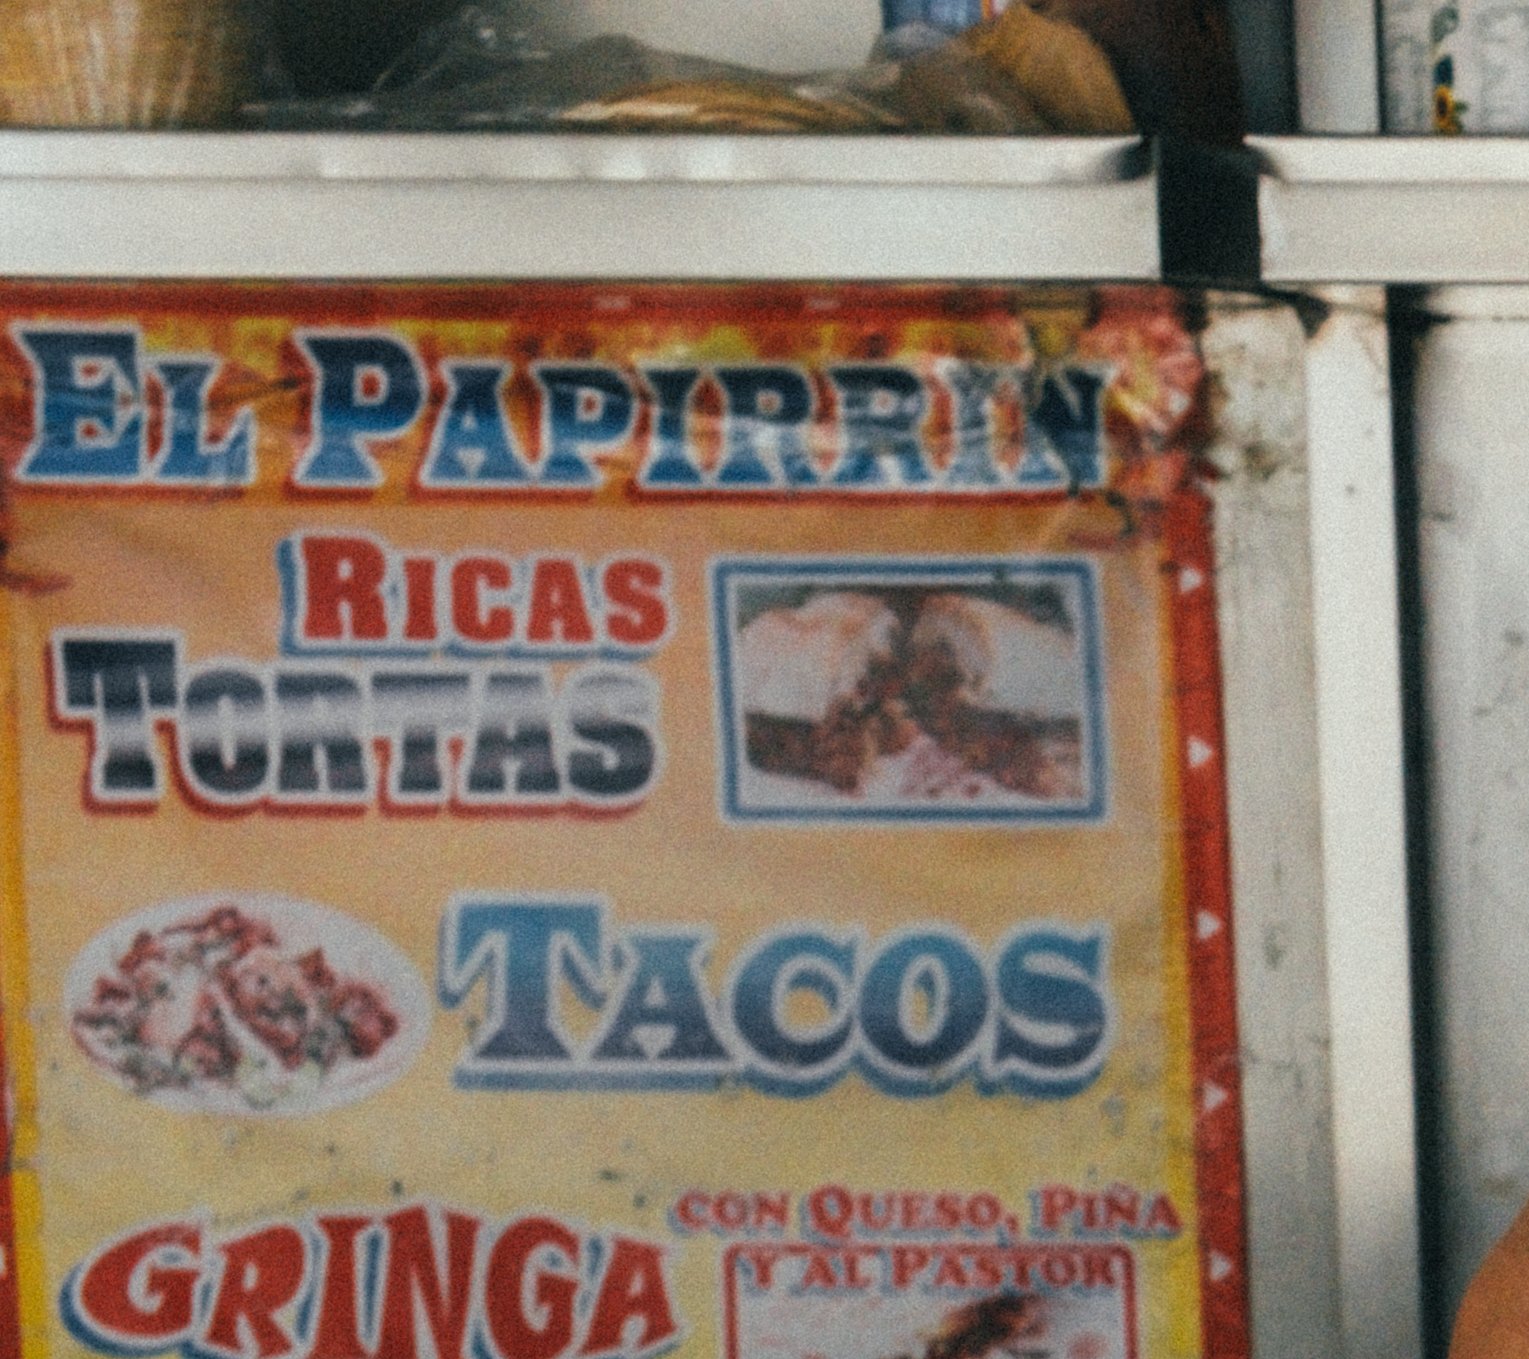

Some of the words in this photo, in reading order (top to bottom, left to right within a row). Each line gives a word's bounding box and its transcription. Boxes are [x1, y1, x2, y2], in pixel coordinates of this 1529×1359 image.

[10, 324, 257, 482] EL
[293, 530, 671, 648] RICAS
[54, 632, 658, 800] TORTAS
[446, 893, 1112, 1082] TACOS
[674, 1187, 790, 1231] CON
[742, 1249, 780, 1290] Y
[803, 1248, 872, 1290] AL
[892, 1247, 1118, 1291] PASTOR
